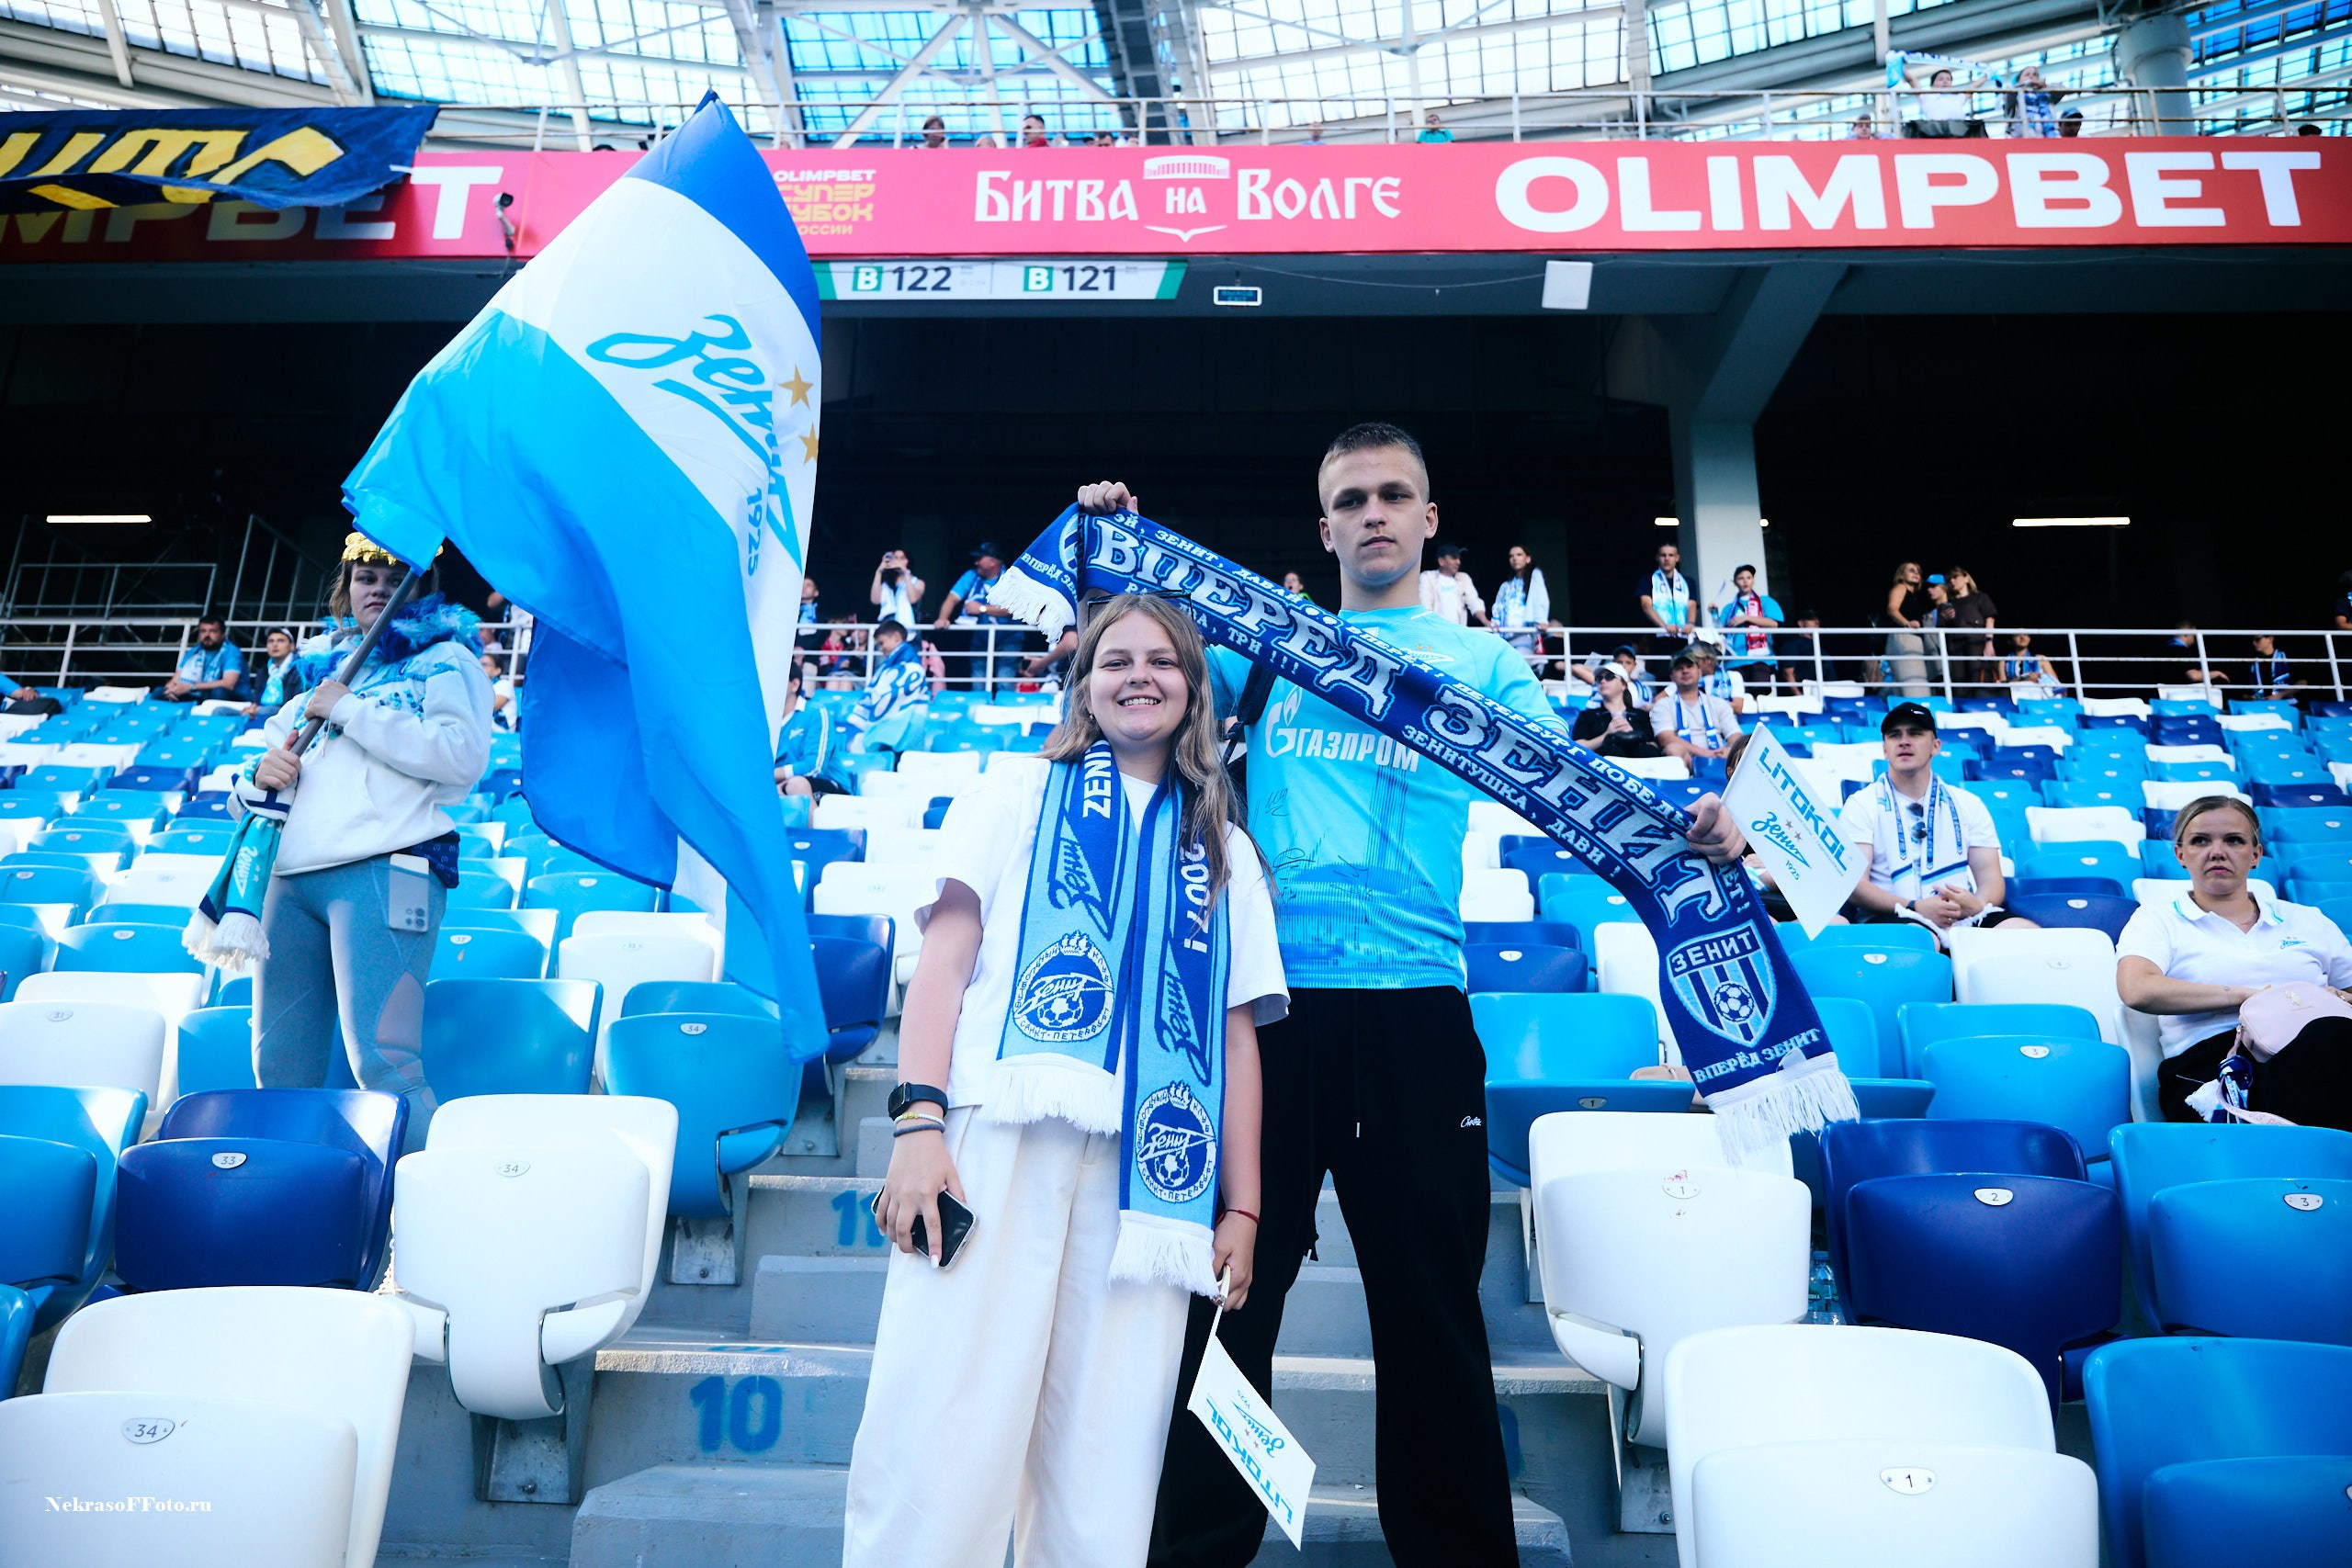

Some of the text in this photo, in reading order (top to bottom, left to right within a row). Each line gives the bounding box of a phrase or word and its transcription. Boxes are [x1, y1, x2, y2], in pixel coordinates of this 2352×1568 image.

[773, 169, 876, 182] OLIMPBET
[1495, 152, 2322, 233] OLIMPBET
[790, 203, 875, 221] УБОК
[799, 224, 853, 235] ОССИИ
[892, 266, 952, 291] 122
[1063, 266, 1116, 291] 121
[747, 487, 763, 577] 1925
[1453, 682, 1587, 756] ПЕТЕРБУРГ
[1295, 728, 1419, 773] ГАЗПРОМ
[1427, 687, 1724, 922] ЗЕНИТ
[1751, 811, 1813, 870] Зенит
[1785, 859, 1801, 881] 1925
[1671, 931, 1752, 973] ЗЕНИТ
[1693, 1027, 1821, 1084] ВПЕРЁД ЗЕНИТ
[221, 1155, 236, 1166] 33
[503, 1163, 521, 1174] 34
[831, 1190, 887, 1247] 11
[133, 1424, 158, 1439] 34
[689, 1375, 783, 1455] 10
[1905, 1472, 1914, 1489] 1
